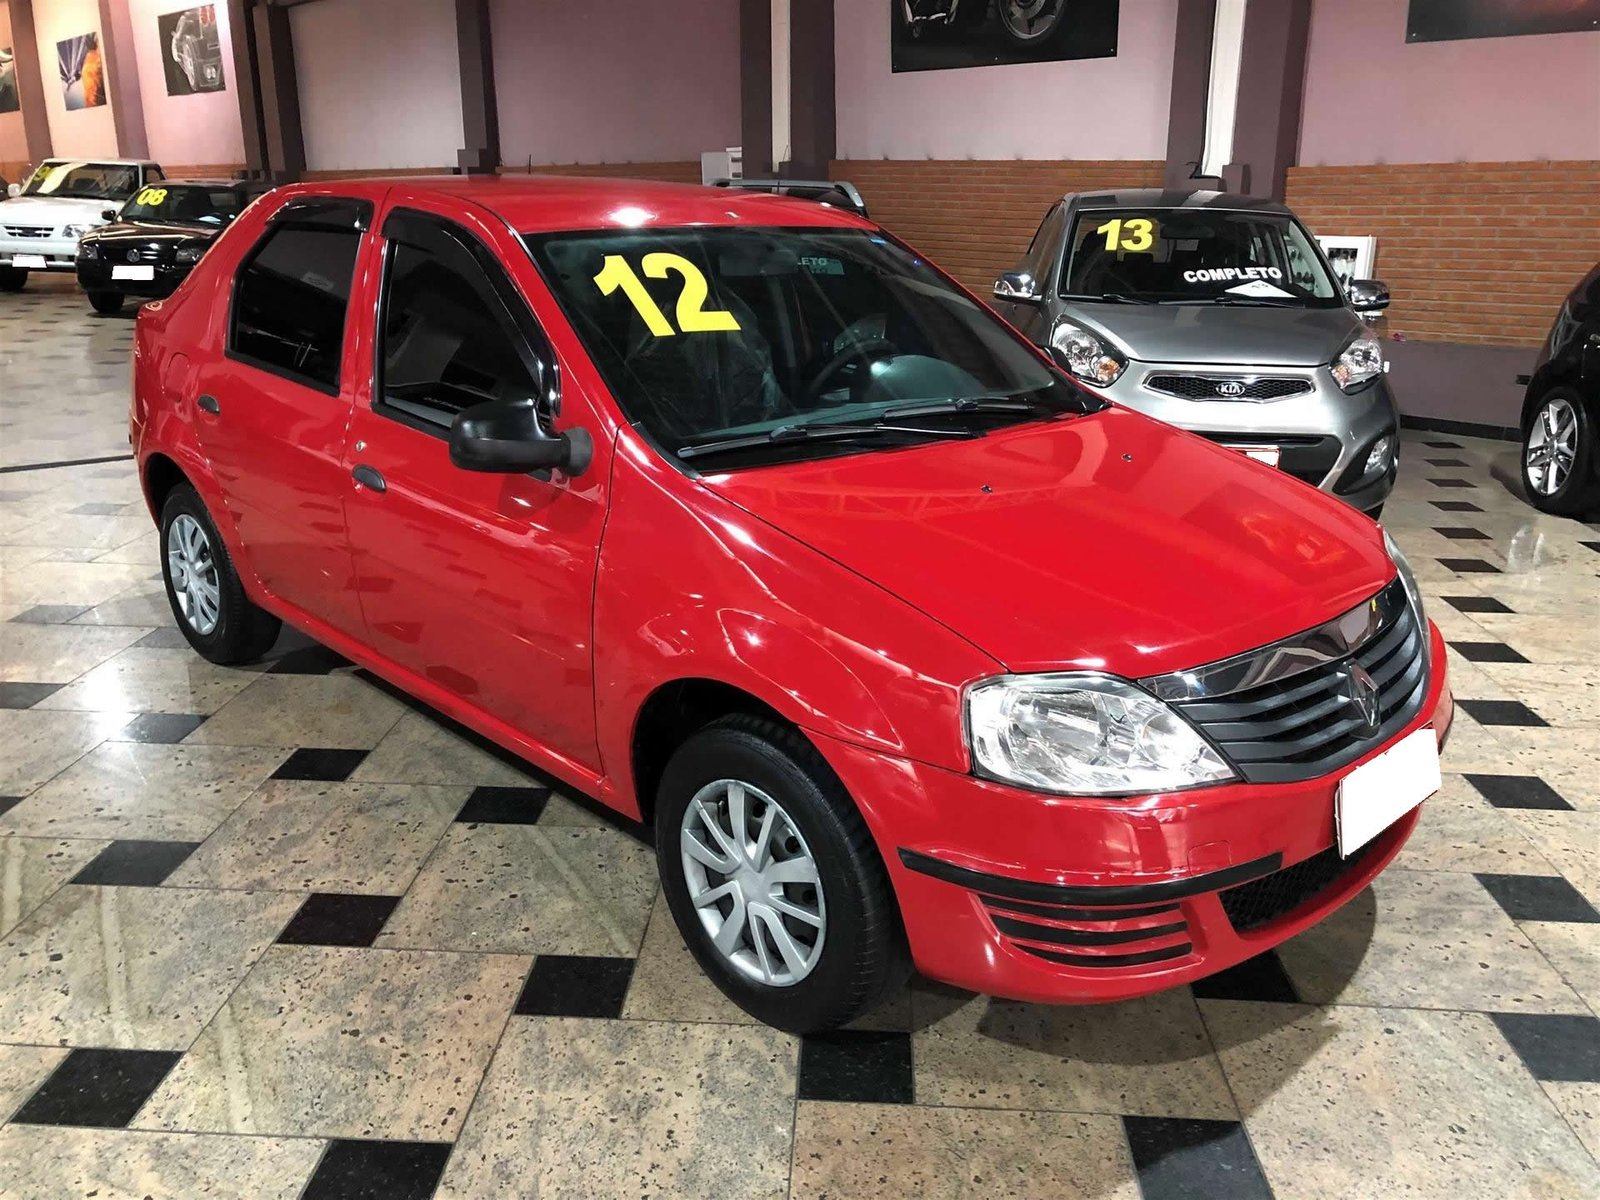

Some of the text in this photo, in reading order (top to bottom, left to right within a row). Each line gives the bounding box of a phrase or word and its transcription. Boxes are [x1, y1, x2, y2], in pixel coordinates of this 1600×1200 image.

[137, 188, 168, 206] 08
[1097, 218, 1153, 251] 13
[1183, 266, 1282, 283] COMPLETO
[593, 252, 742, 337] 12
[1220, 384, 1241, 394] KIA
